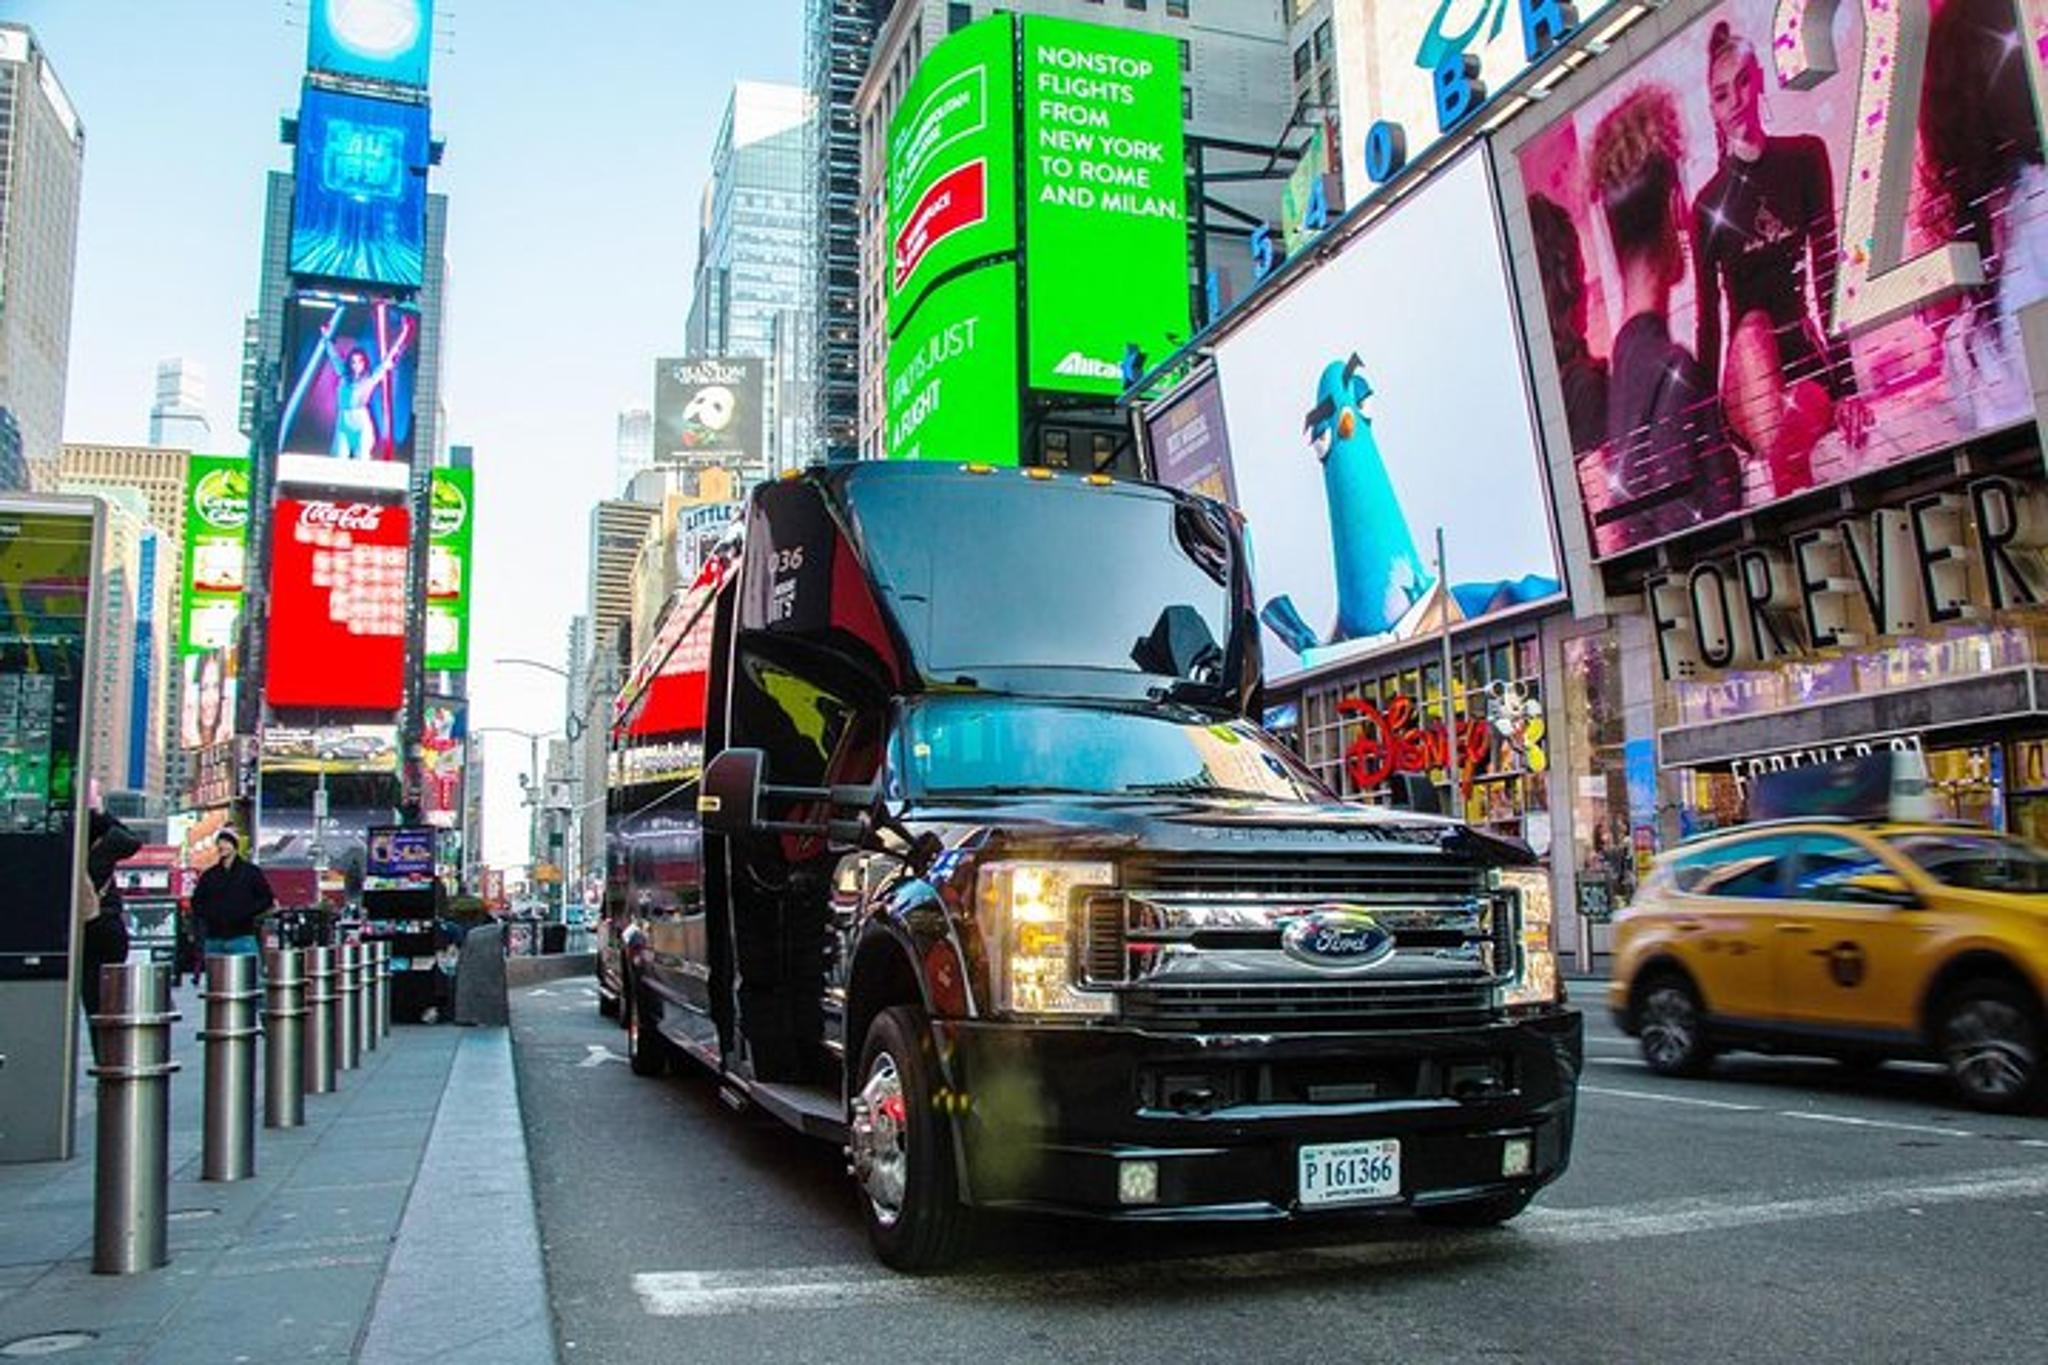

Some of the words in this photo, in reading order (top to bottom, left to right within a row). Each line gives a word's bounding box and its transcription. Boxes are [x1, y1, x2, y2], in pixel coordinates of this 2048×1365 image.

[1037, 45, 1154, 80] NONSTOP
[1037, 72, 1135, 105] FLIGHTS
[1039, 101, 1111, 129] FROM
[1039, 128, 1094, 153] NEW
[1099, 136, 1165, 163] YORK
[1039, 155, 1074, 178] TO
[1079, 160, 1151, 189] ROME
[1039, 184, 1096, 209] AND
[1101, 191, 1184, 221] MILAN.
[297, 500, 384, 531] Coca-Cola
[686, 504, 732, 532] LITTLE
[1645, 474, 2044, 683] FOREVER
[1335, 693, 1492, 800] Disney
[1315, 928, 1369, 953] Ford
[1305, 1162, 1319, 1190] P
[1325, 1154, 1393, 1188] 161366
